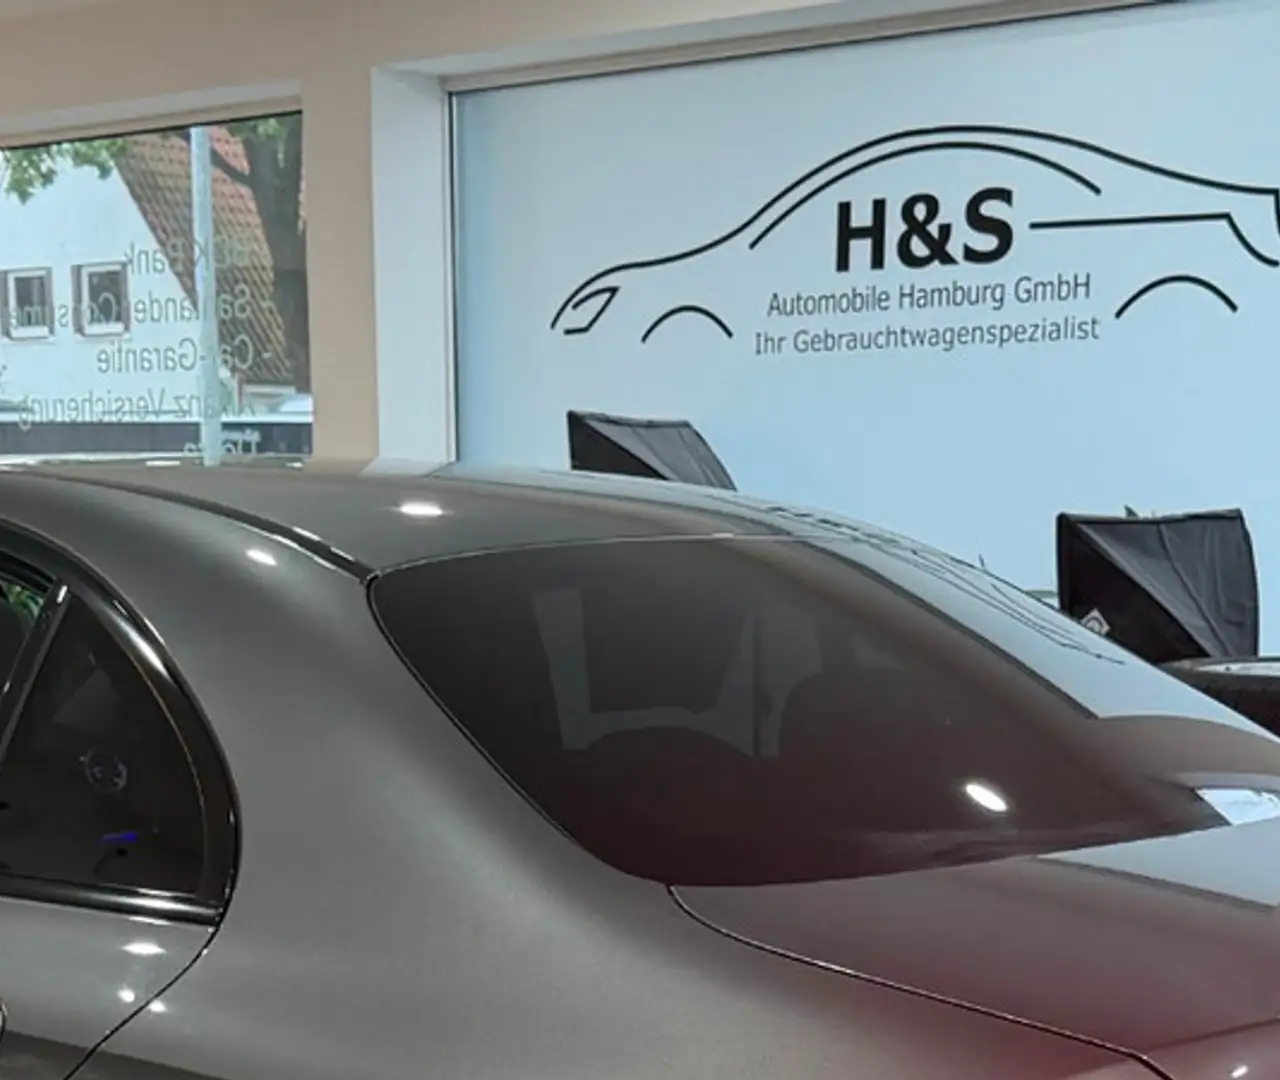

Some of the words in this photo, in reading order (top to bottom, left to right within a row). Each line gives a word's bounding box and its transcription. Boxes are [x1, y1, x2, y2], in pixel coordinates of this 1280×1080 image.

[835, 187, 1014, 273] H&S
[767, 285, 891, 318] Automobile
[898, 281, 1006, 311] Hamburg
[1013, 272, 1091, 304] GmbH
[754, 331, 787, 355] Ihr
[793, 315, 1101, 354] Gebrauchtwagenspezialist
